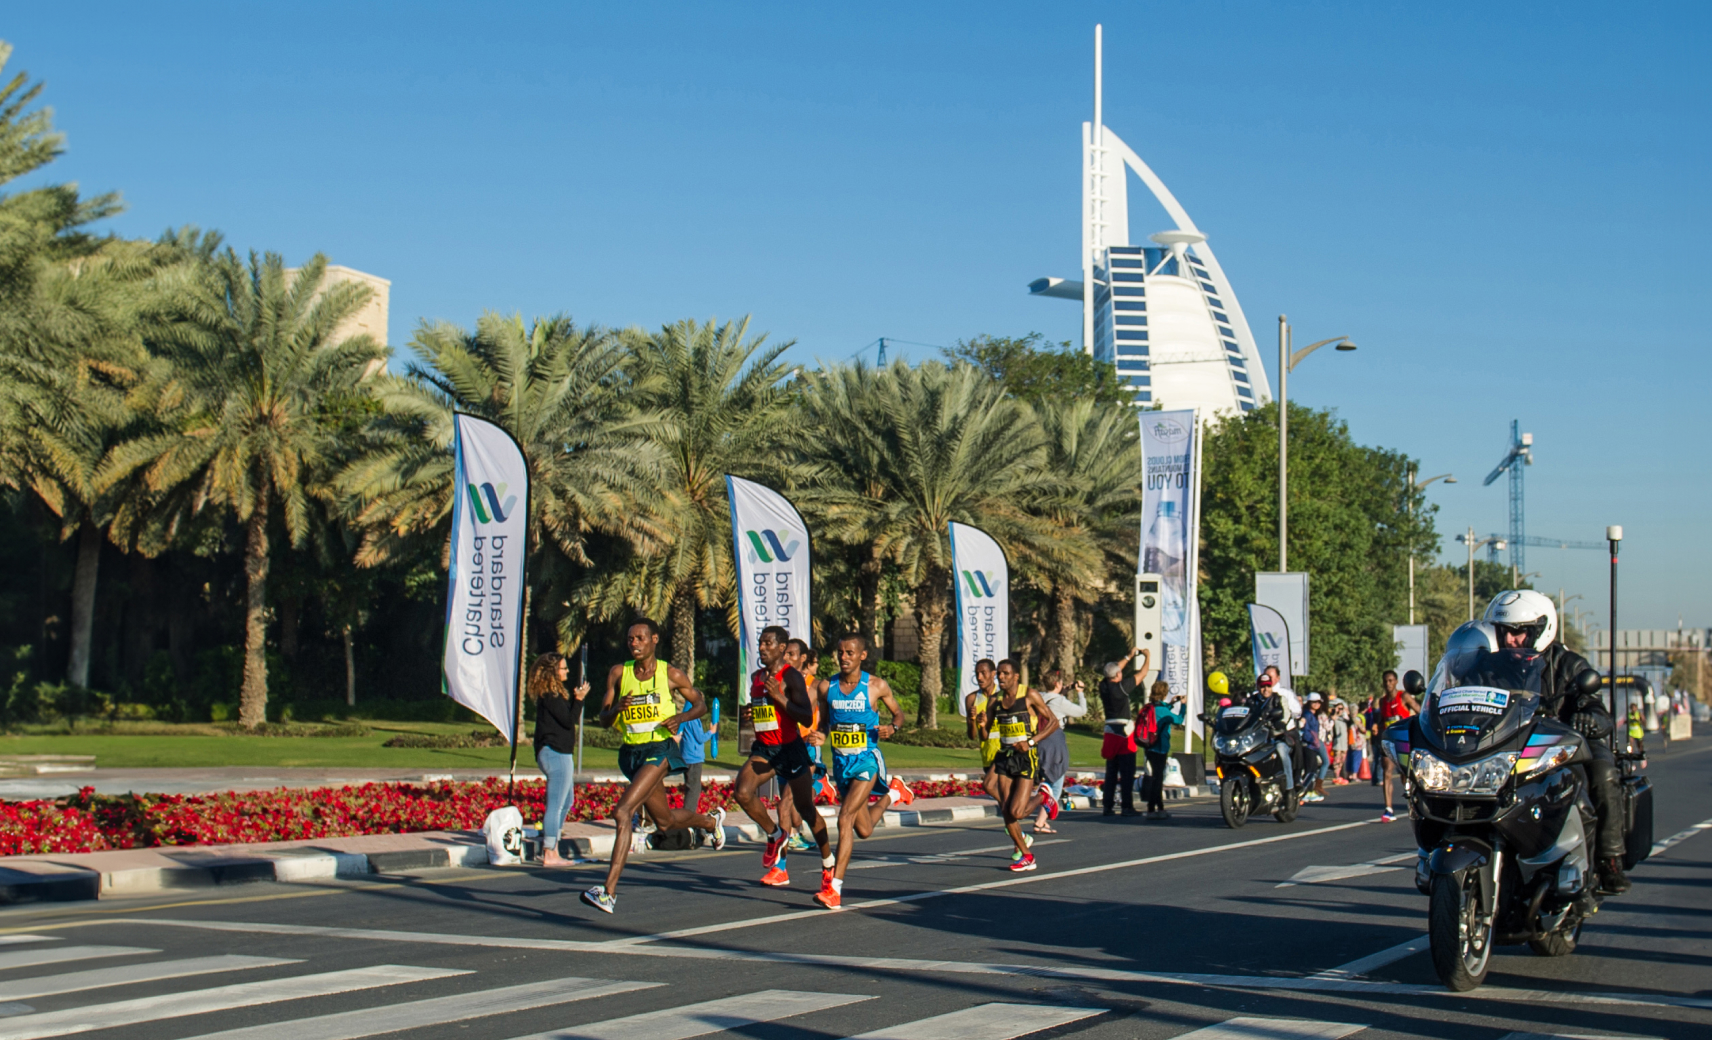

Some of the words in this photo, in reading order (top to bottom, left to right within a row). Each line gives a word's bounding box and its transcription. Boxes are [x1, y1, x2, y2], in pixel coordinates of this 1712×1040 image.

[752, 707, 774, 719] EMMA
[1439, 705, 1470, 714] OFFICIAL
[1471, 705, 1503, 715] VEHICLE
[833, 732, 865, 746] ROBI
[1457, 735, 1466, 744] A
